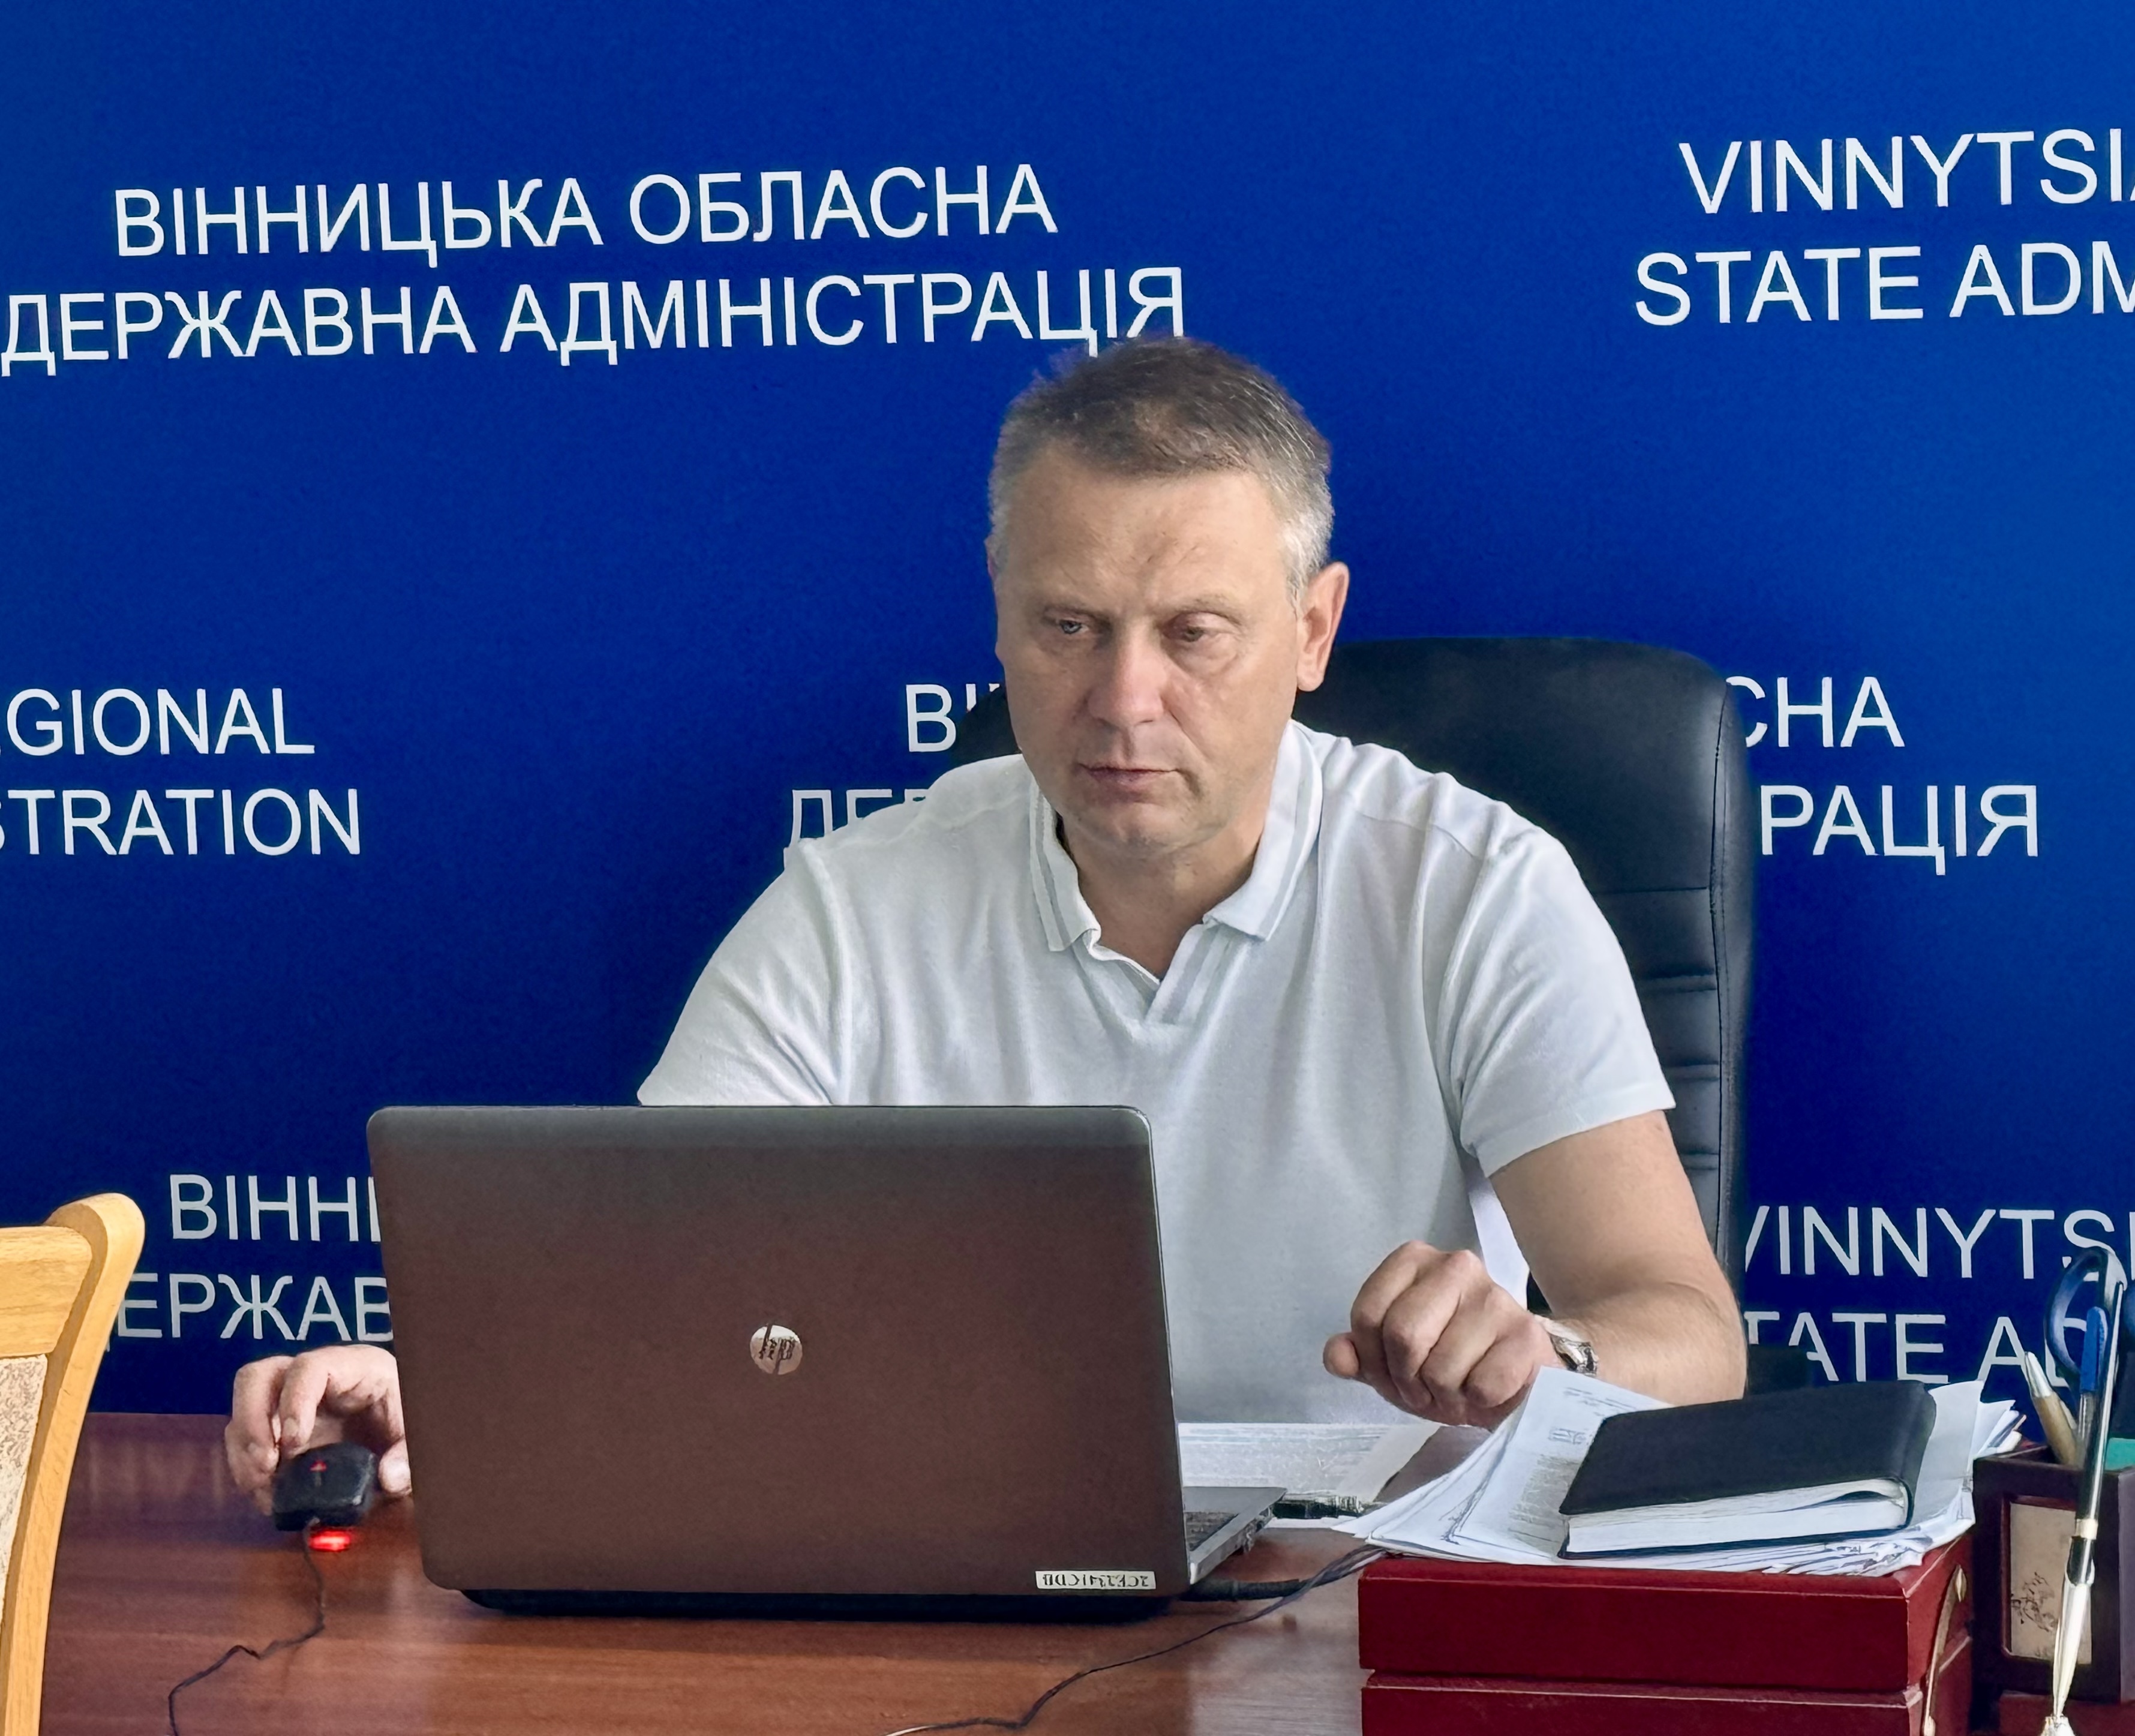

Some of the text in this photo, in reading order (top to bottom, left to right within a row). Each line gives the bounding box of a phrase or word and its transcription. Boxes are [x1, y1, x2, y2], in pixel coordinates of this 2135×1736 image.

[1679, 128, 2135, 214] VINNYTSI
[116, 164, 1058, 268] ВІННИЦЬКА ОБЛАСНА
[1, 267, 1185, 377] ДЕРЖАВНА АДМІНІСТРАЦІЯ
[1636, 241, 2135, 325] STATE ADM
[0, 788, 360, 855] TRATION
[1760, 785, 2038, 875] РАЦІЯ
[107, 1273, 394, 1351] ЕРЖАВ
